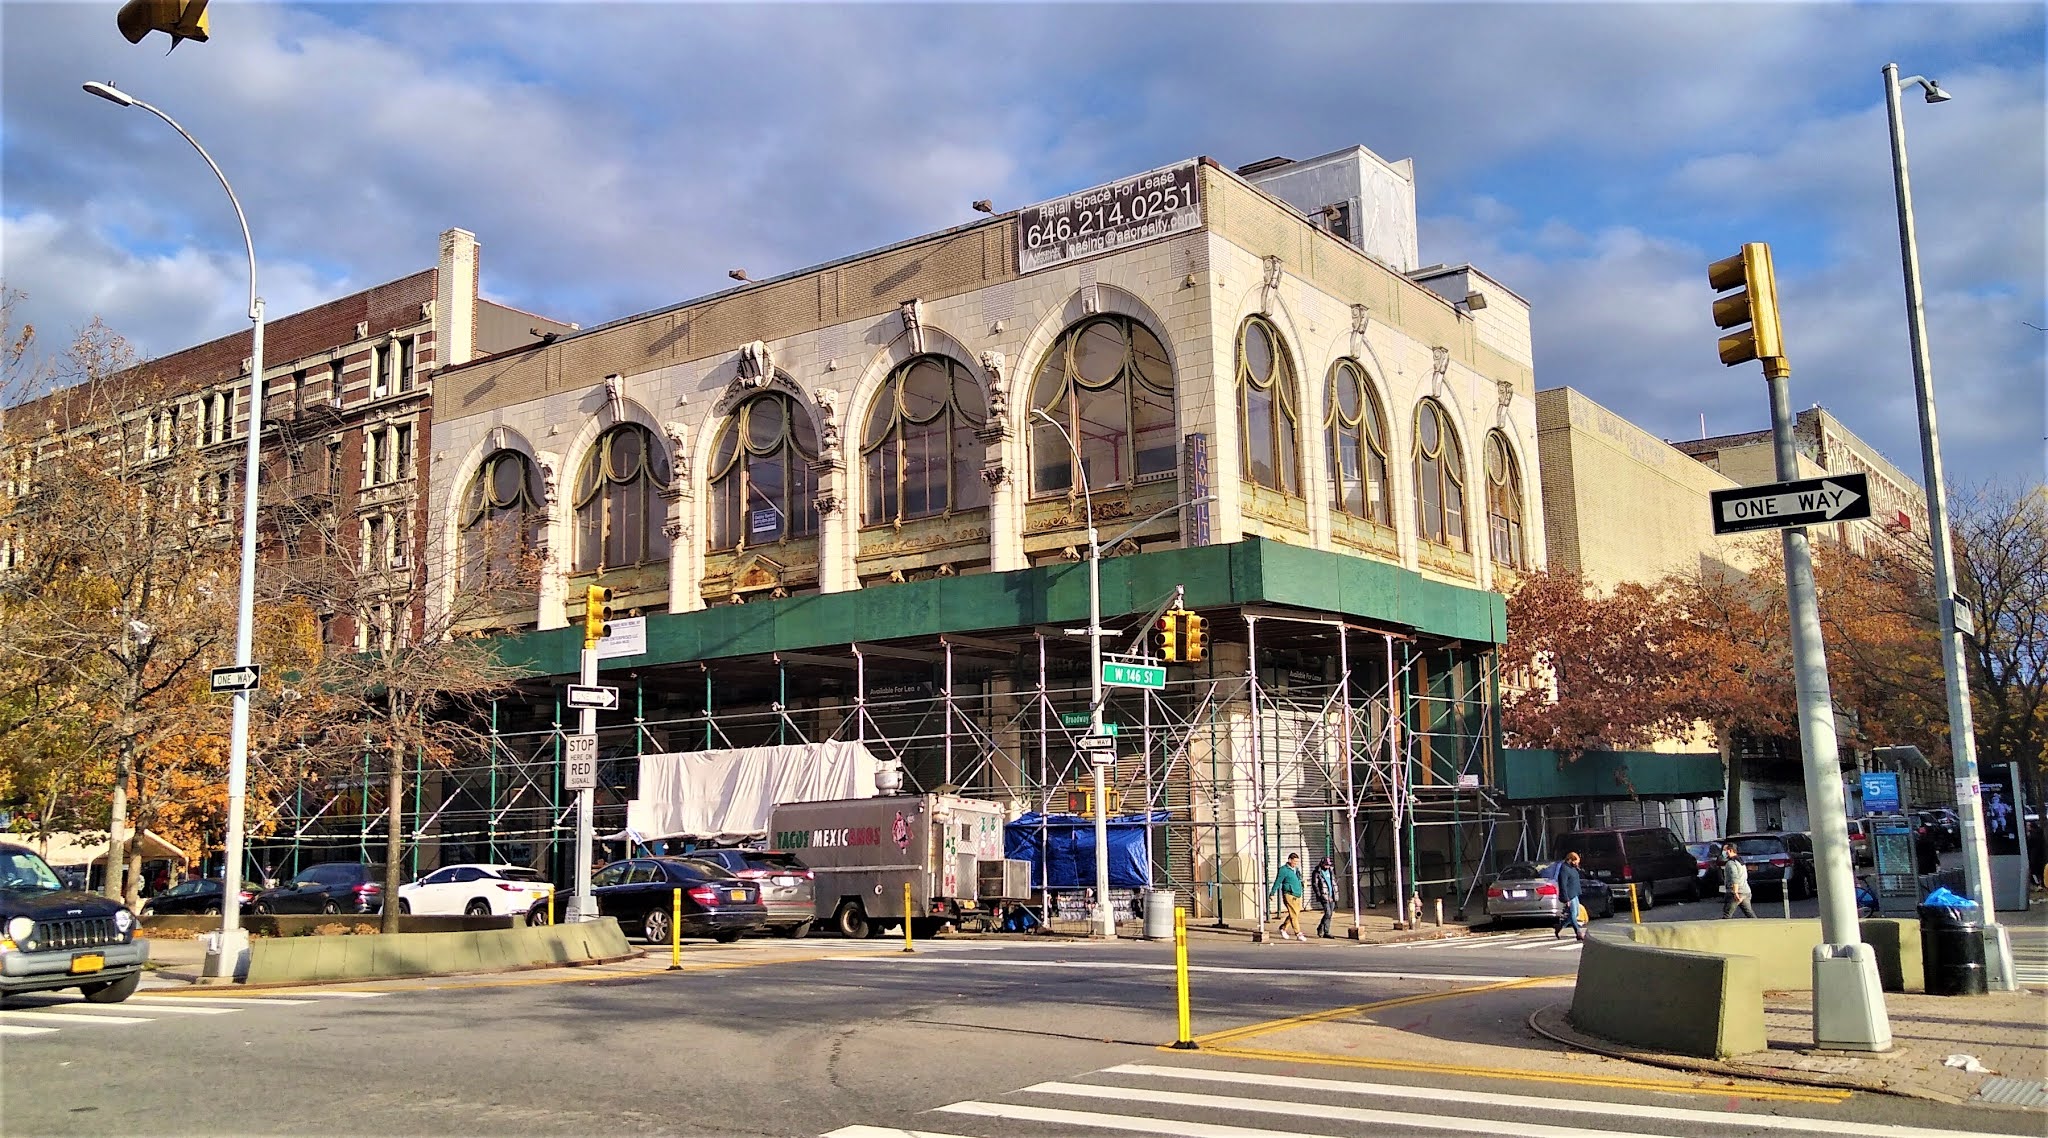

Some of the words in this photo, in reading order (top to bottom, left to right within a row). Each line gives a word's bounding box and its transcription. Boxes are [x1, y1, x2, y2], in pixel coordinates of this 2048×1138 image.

[1039, 202, 1071, 219] Retail
[1074, 190, 1111, 210] Space
[1114, 182, 1135, 199] For
[1138, 172, 1175, 193] Lease
[1027, 182, 1192, 249] 646.214.0251
[1734, 498, 1779, 519] ONE
[1798, 490, 1844, 511] WAY
[217, 675, 231, 685] ONE
[237, 673, 252, 683] WAY
[1114, 668, 1123, 681] W
[1126, 669, 1140, 682] 146
[1144, 671, 1153, 684] St
[870, 687, 893, 695] Available
[1065, 715, 1090, 725] Broadway
[569, 739, 594, 752] STOP
[571, 763, 590, 775] RED
[571, 777, 590, 785] SIGNAL
[777, 830, 809, 849] TACOS
[812, 827, 881, 848] MEXICANOS
